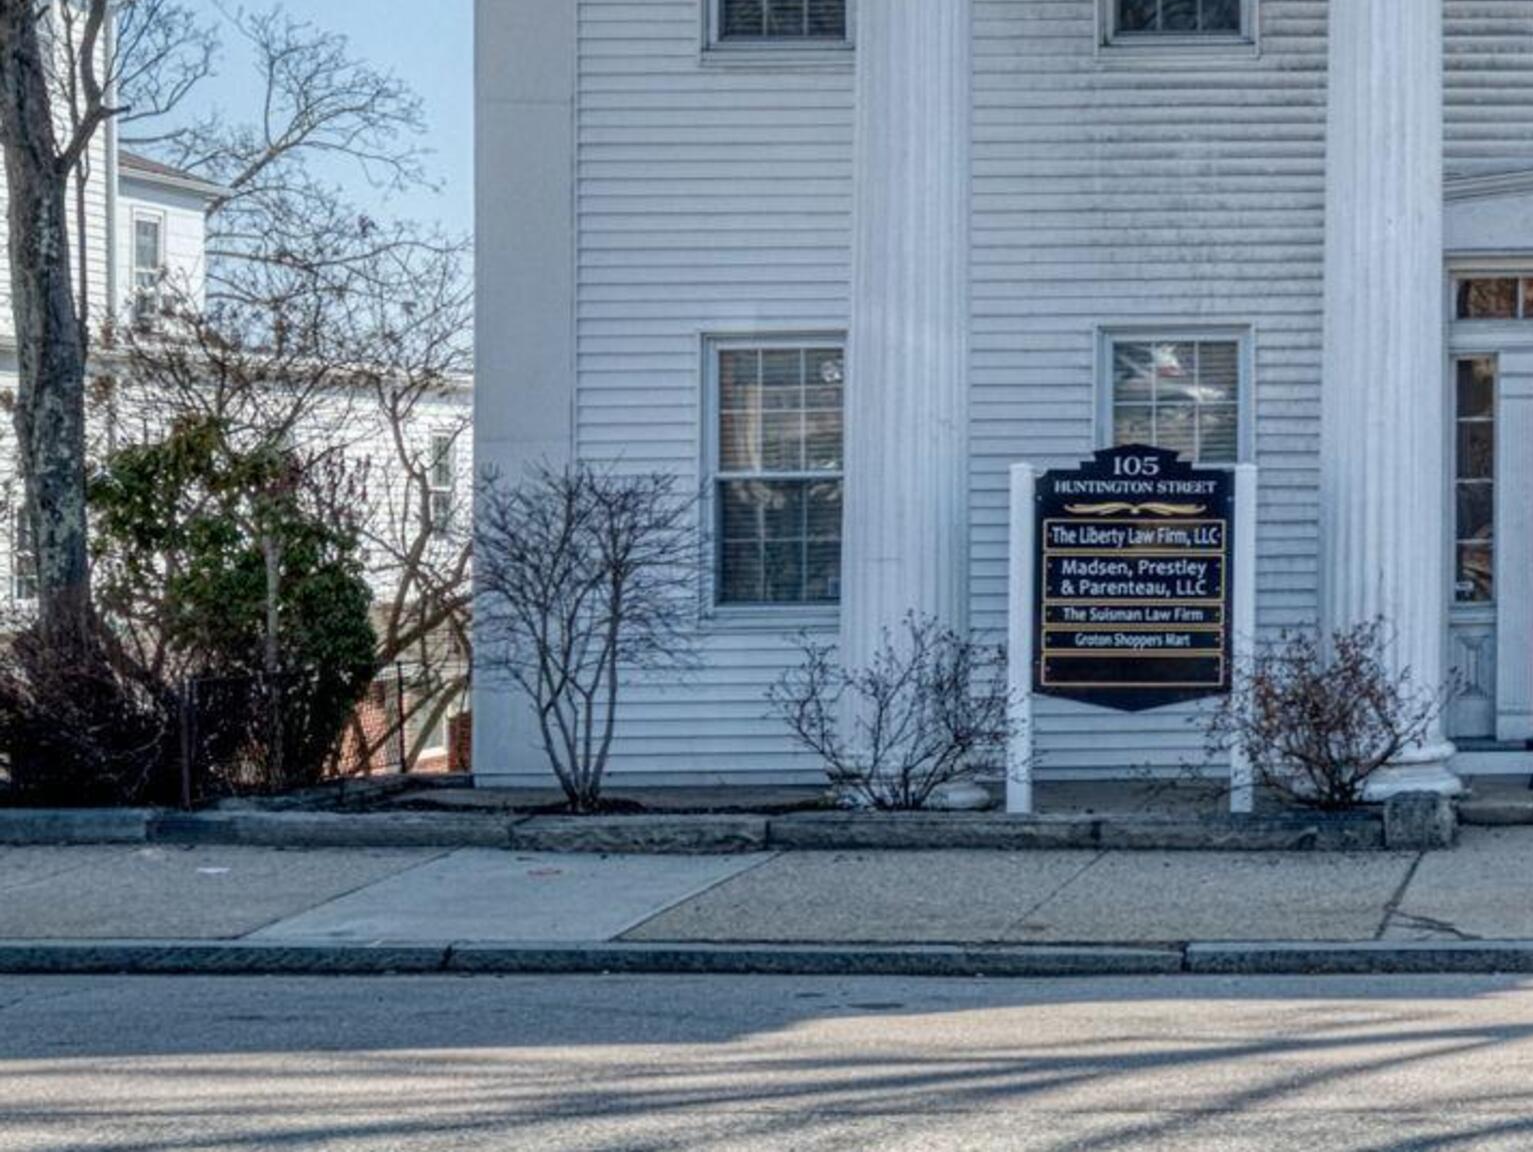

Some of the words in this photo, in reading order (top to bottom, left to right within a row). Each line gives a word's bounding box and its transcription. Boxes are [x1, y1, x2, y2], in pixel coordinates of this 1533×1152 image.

[1113, 456, 1160, 475] 105
[1054, 480, 1154, 494] HUNTINGTON
[1156, 480, 1217, 494] STREET
[1052, 526, 1077, 544] The
[1079, 526, 1126, 548] Liberty
[1128, 528, 1155, 544] Law
[1157, 528, 1191, 546] Firm,
[1194, 528, 1218, 544] LLC
[1062, 559, 1133, 577] Madsen,
[1138, 559, 1207, 578] Prestley
[1061, 580, 1075, 595] &
[1079, 580, 1171, 597] Parenteau,
[1176, 579, 1207, 595] LLC
[1063, 607, 1087, 621] The
[1090, 607, 1142, 621] Suisman
[1145, 608, 1171, 621] Law
[1174, 608, 1204, 621] Firm
[1075, 633, 1113, 646] Groton
[1114, 633, 1163, 651] Shoppers
[1166, 633, 1191, 646] Mart
